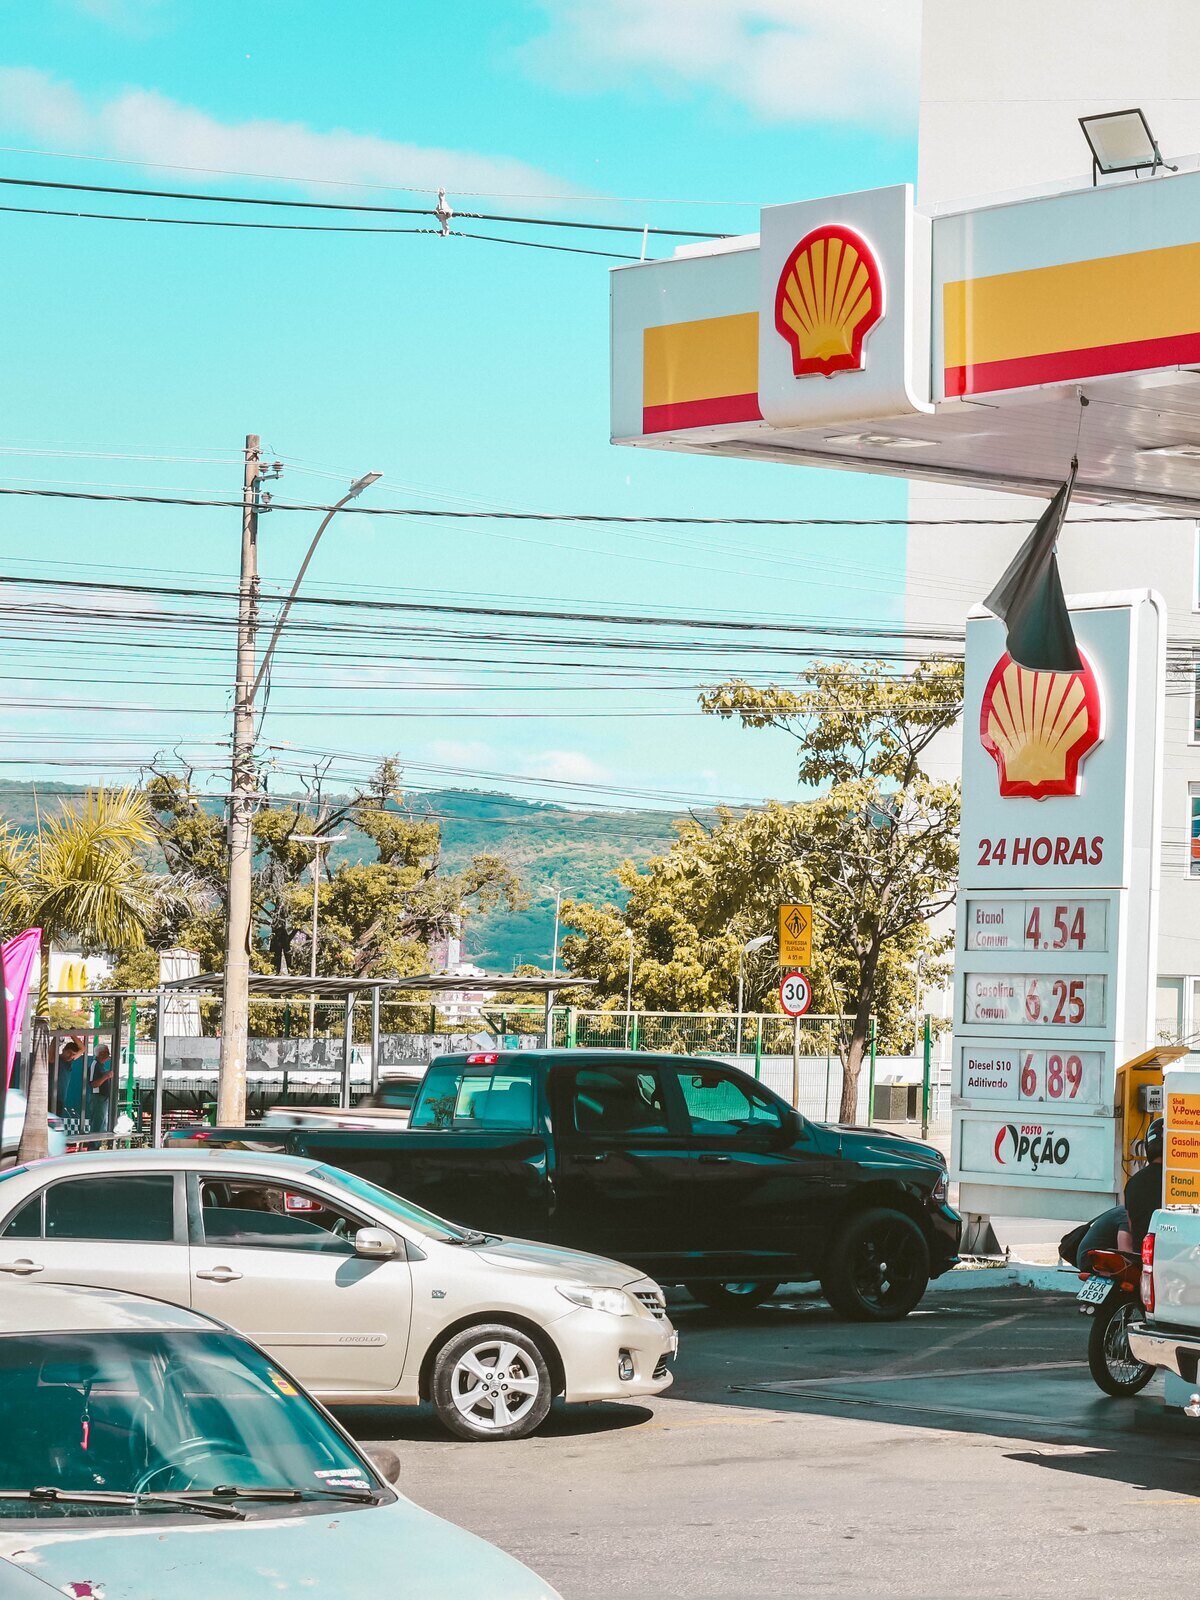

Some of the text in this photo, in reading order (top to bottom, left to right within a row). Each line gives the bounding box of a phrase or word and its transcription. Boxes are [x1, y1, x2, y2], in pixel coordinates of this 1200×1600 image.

[977, 836, 1104, 866] 24 HORAS
[976, 908, 1004, 924] Etanol
[1026, 906, 1086, 950] 4.54
[976, 932, 1008, 946] Comum
[785, 983, 805, 1001] 30
[976, 982, 1014, 998] Gasolina
[1025, 979, 1085, 1024] 6.25
[968, 1059, 1012, 1071] Diesel S10
[968, 1077, 1008, 1088] Aditivado
[1021, 1053, 1083, 1102] 6.89
[1171, 1118, 1194, 1126] Gasolina
[1020, 1125, 1042, 1135] POSTO
[1171, 1149, 1199, 1159] Comum
[1170, 1175, 1195, 1185] Etanol
[1170, 1187, 1199, 1198] Comum
